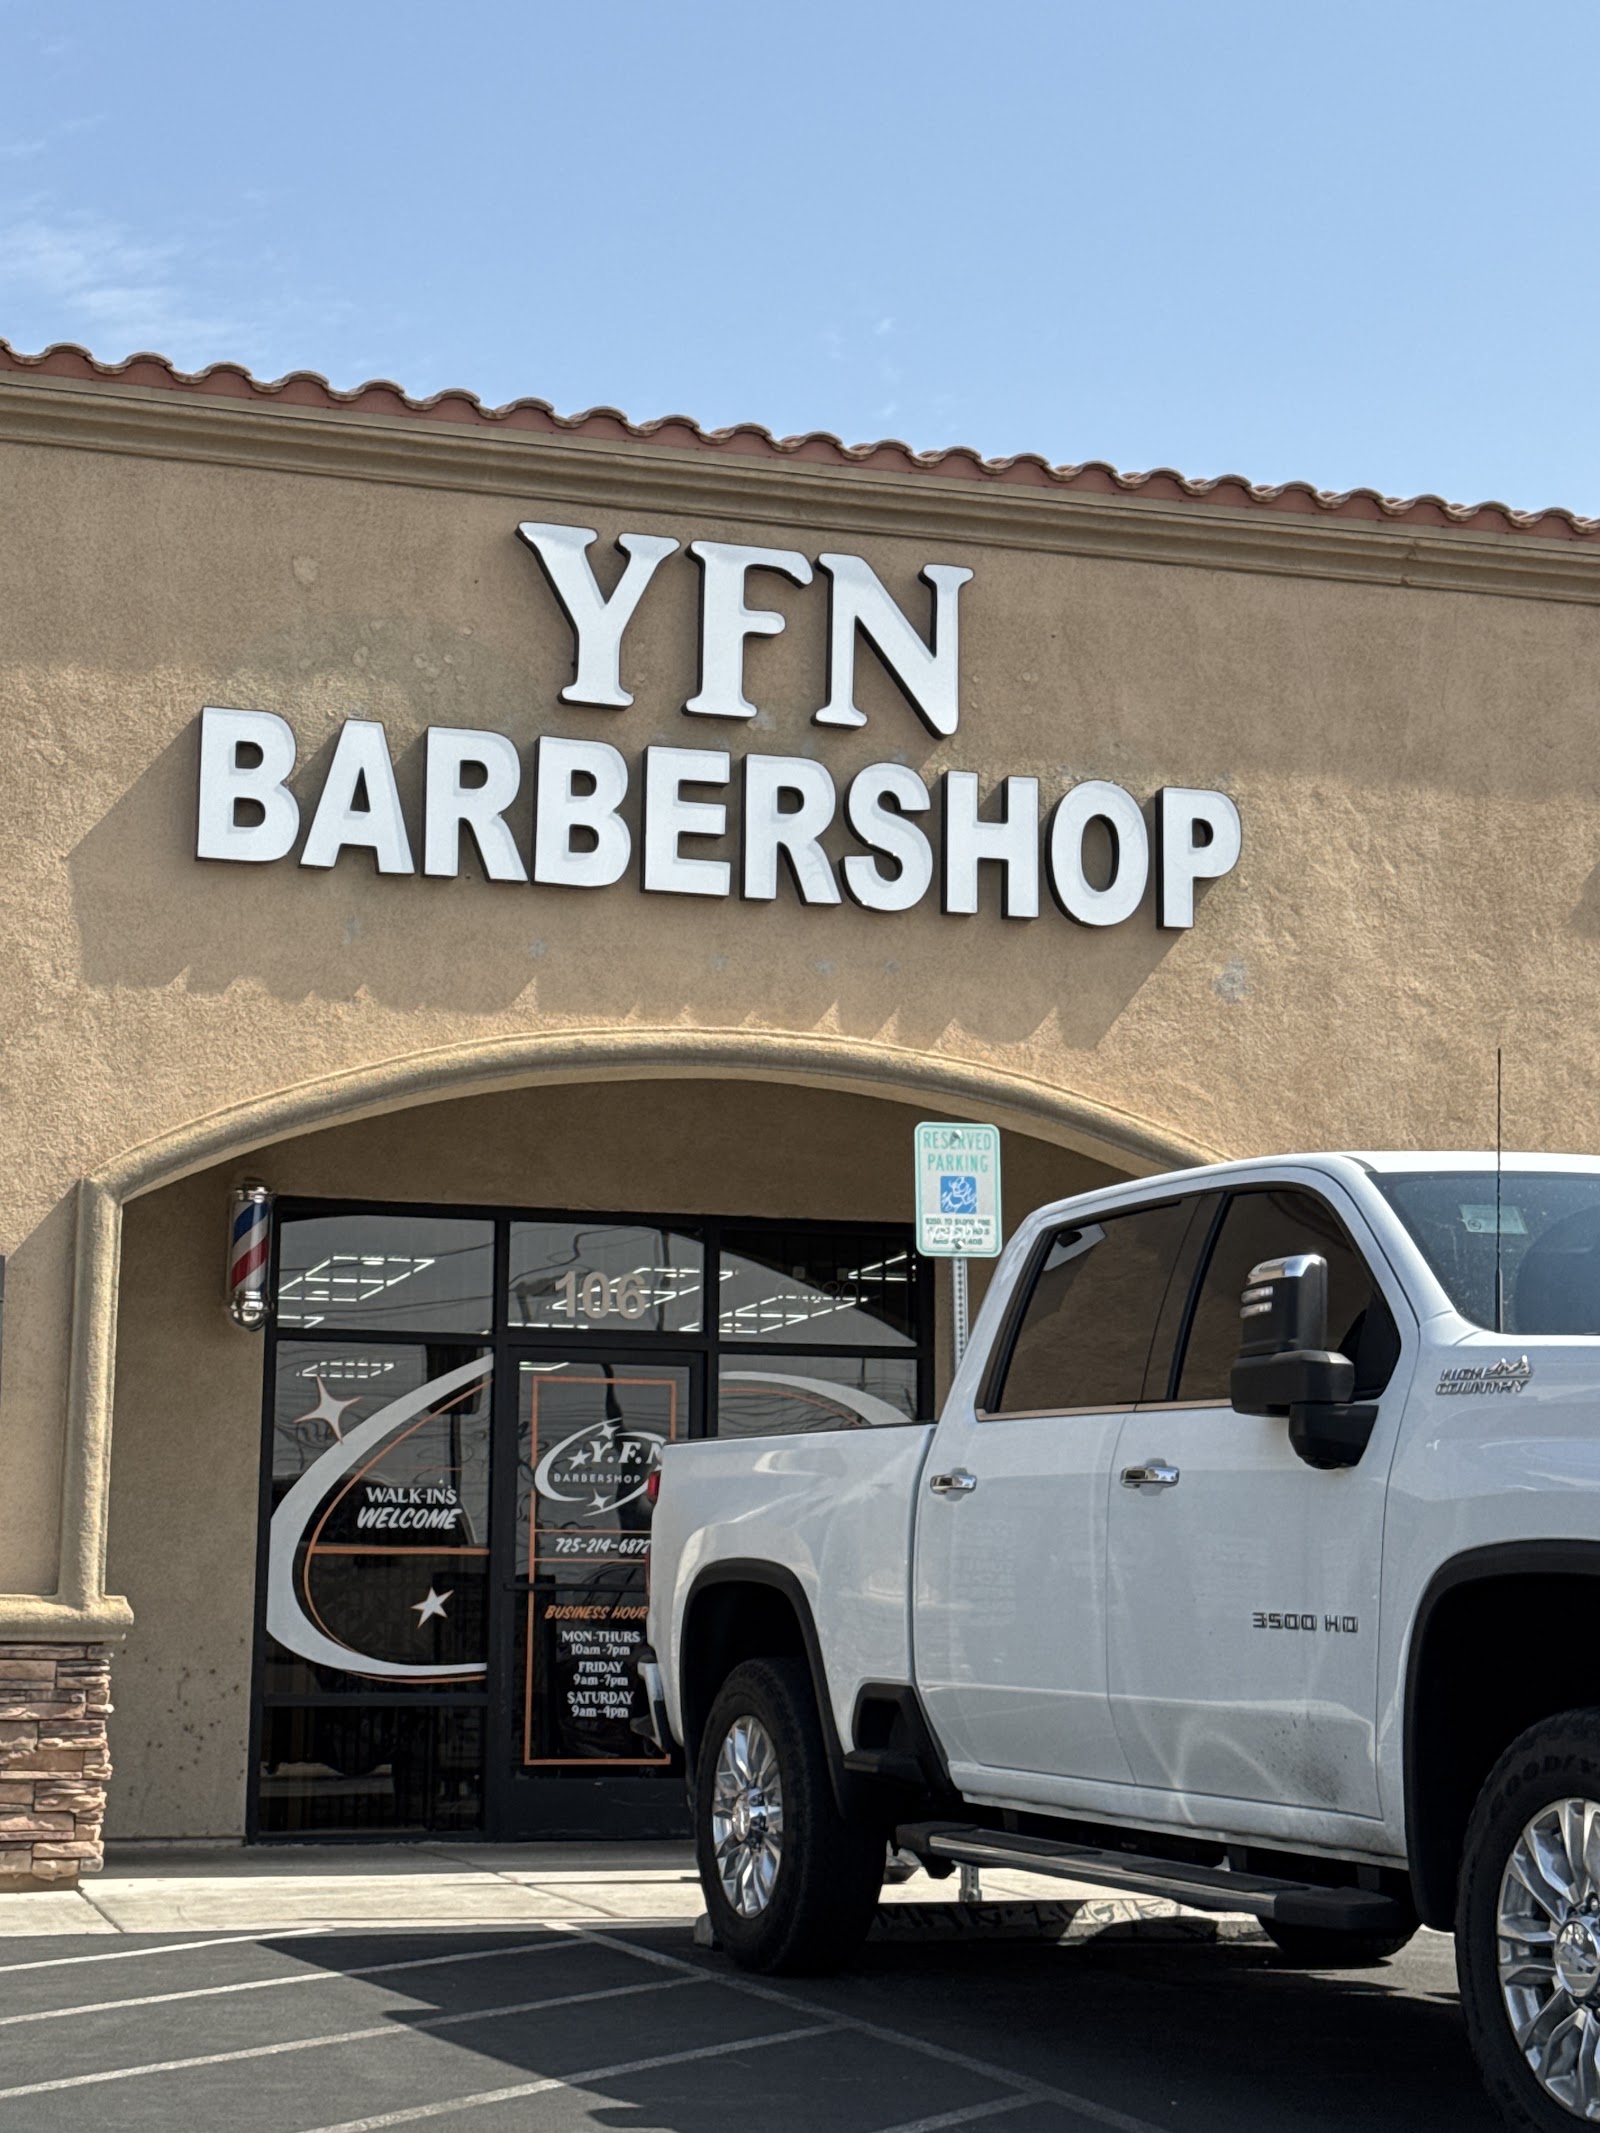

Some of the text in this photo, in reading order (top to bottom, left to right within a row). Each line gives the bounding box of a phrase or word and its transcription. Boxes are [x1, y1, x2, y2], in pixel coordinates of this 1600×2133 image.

[516, 521, 975, 740] YFN
[195, 705, 1243, 930] BARBERSHOP
[927, 1153, 989, 1173] PARKING
[555, 1270, 647, 1320] 106
[1439, 1367, 1488, 1381] HIGH
[1435, 1380, 1530, 1396] COUNTRY
[553, 1473, 642, 1484] BARBERSHOP
[365, 1486, 458, 1505] WALK-INS
[356, 1505, 463, 1530] WELCOME
[544, 1605, 649, 1620] BUSINESS HOUR
[1252, 1611, 1318, 1631] 3500
[561, 1630, 641, 1643] MON-THURS
[578, 1661, 624, 1673] FRIDAY
[566, 1691, 635, 1705] SATURDAY
